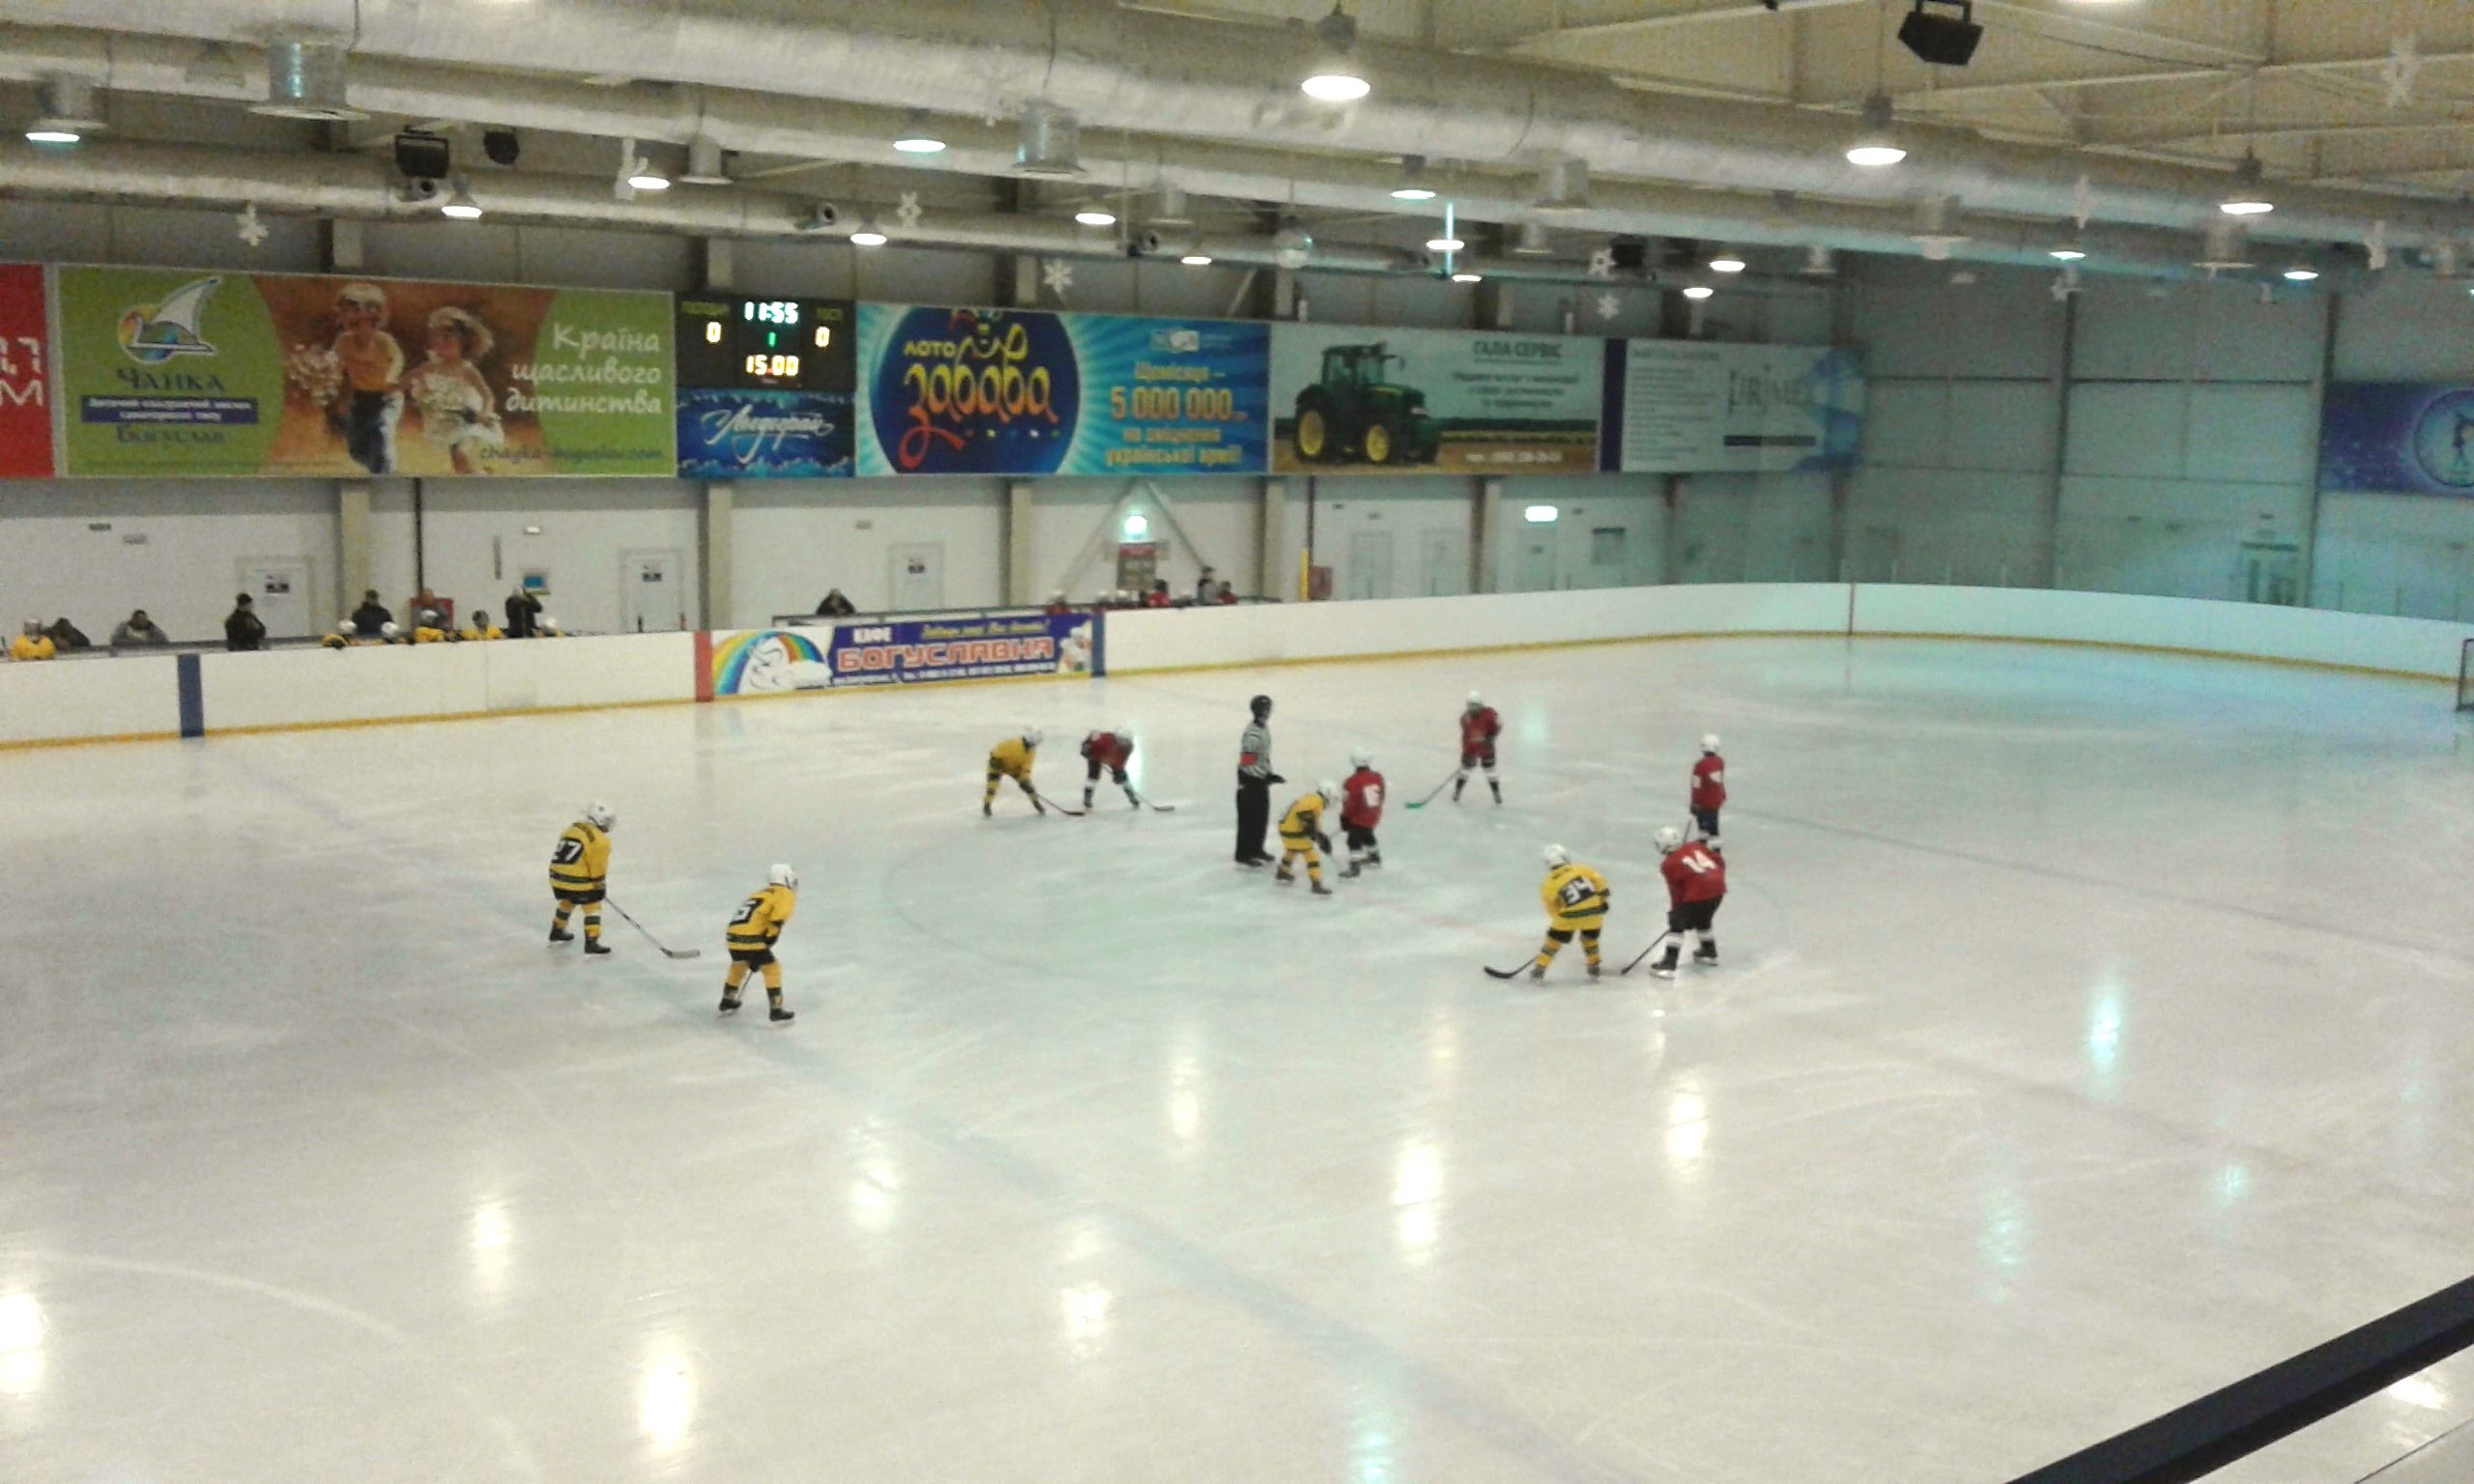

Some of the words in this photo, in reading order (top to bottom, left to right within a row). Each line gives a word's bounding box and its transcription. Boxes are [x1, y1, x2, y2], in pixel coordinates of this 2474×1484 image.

[743, 301, 799, 324] 11:55
[553, 323, 660, 360] Країна
[705, 321, 722, 344] 0
[767, 331, 777, 348] 1
[815, 326, 830, 348] 0
[904, 341, 957, 358] ЛОТО
[511, 356, 662, 385] щасливого
[505, 387, 662, 414] дитинства
[836, 636, 1054, 673] БОГУСЛАВНА
[1565, 877, 1596, 905] 34
